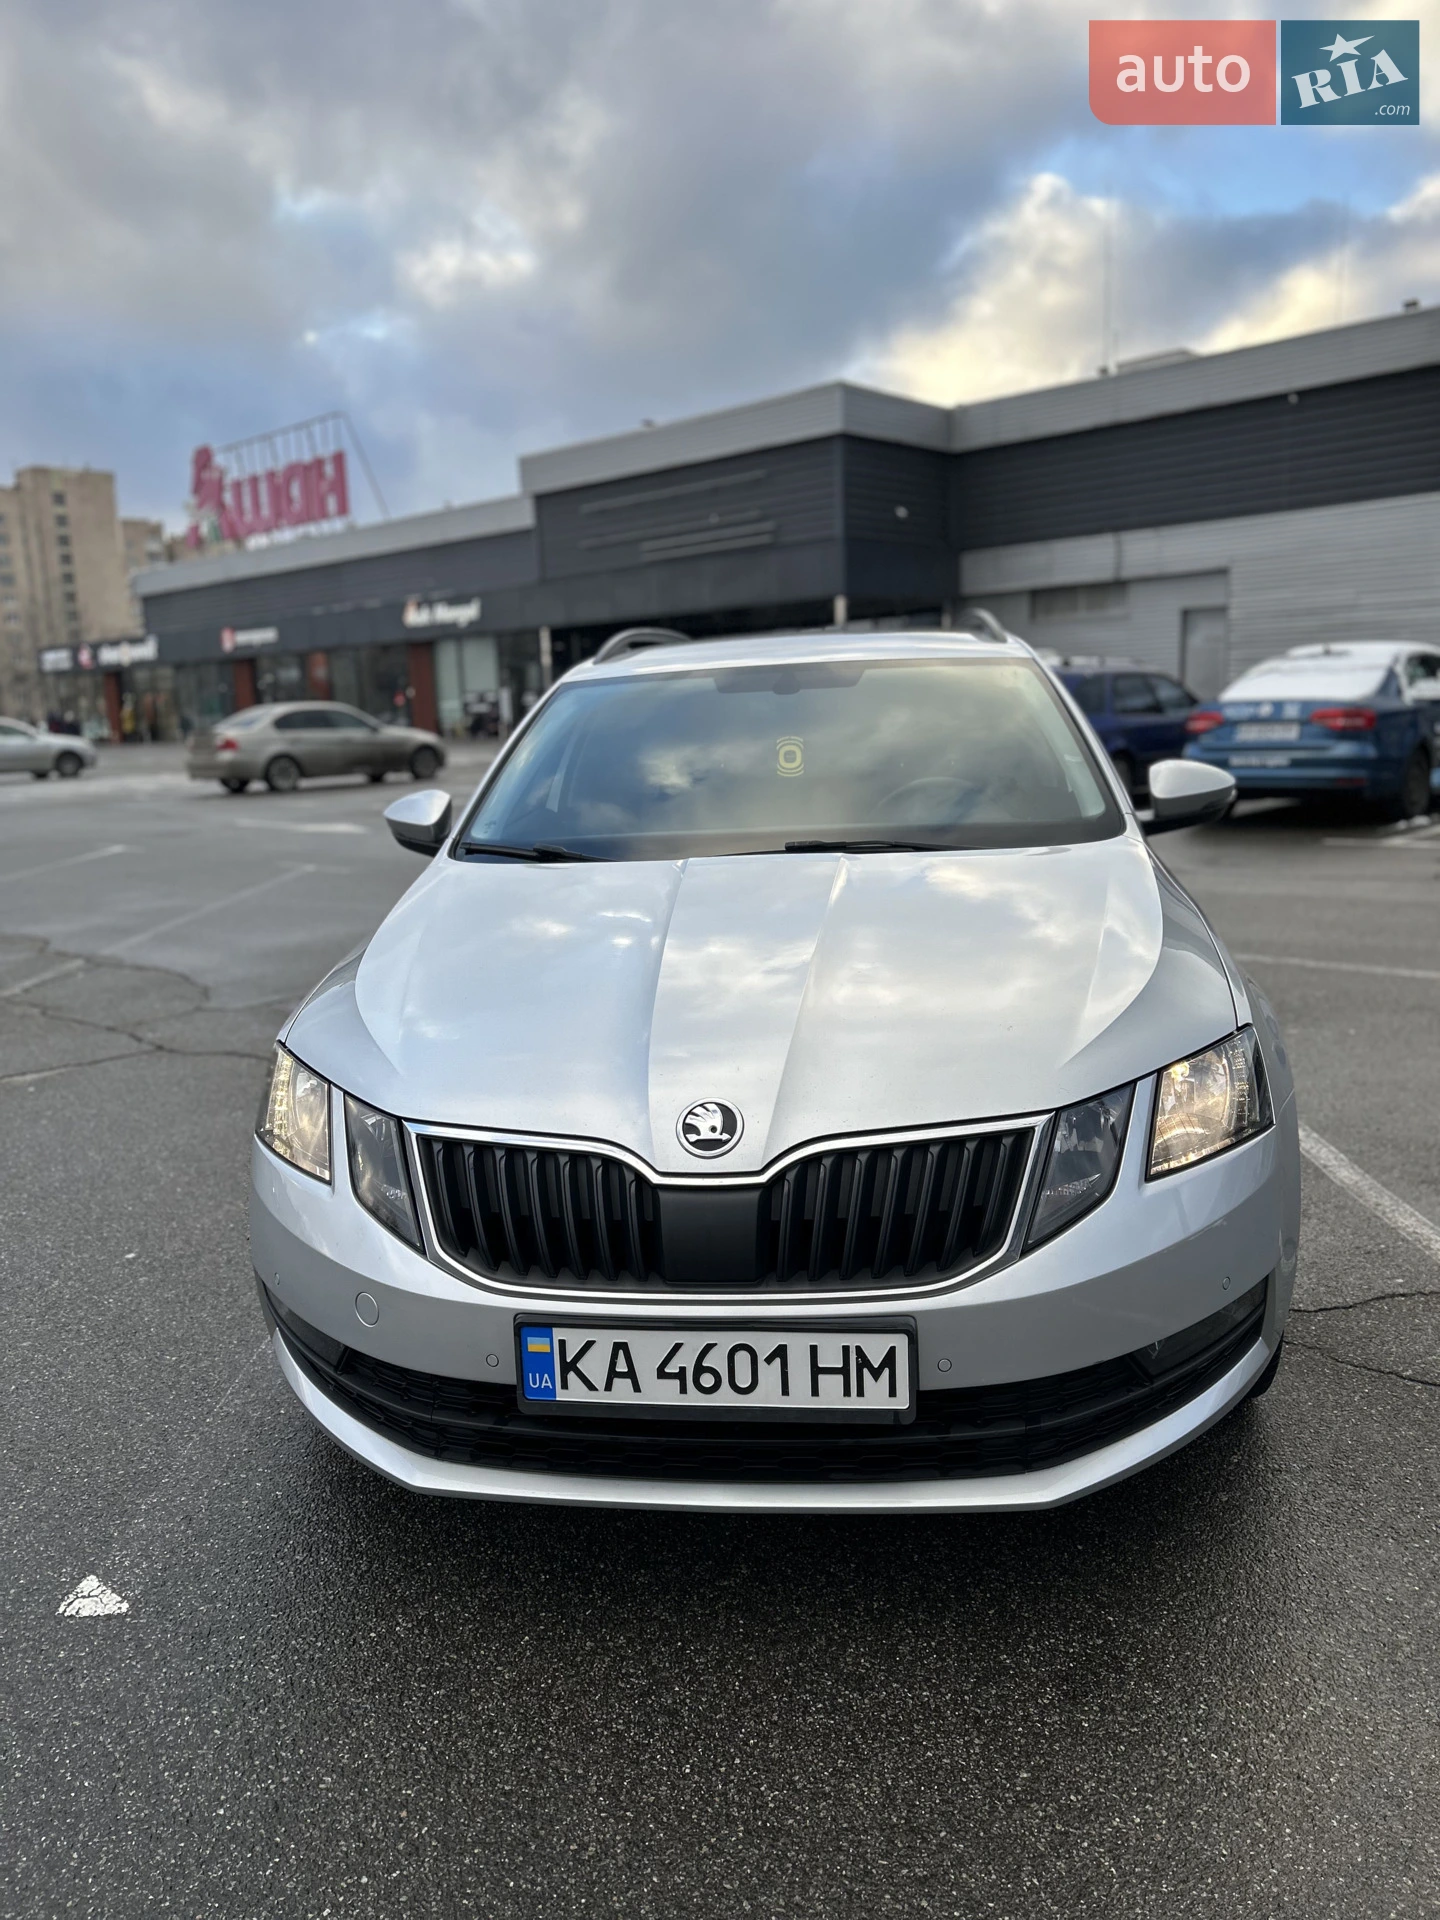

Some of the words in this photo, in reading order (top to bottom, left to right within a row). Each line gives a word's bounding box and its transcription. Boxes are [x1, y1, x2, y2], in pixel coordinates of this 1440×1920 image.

[528, 1371, 553, 1389] UA
[557, 1338, 642, 1393] KA
[656, 1342, 790, 1397] 4601
[810, 1343, 898, 1398] HM
